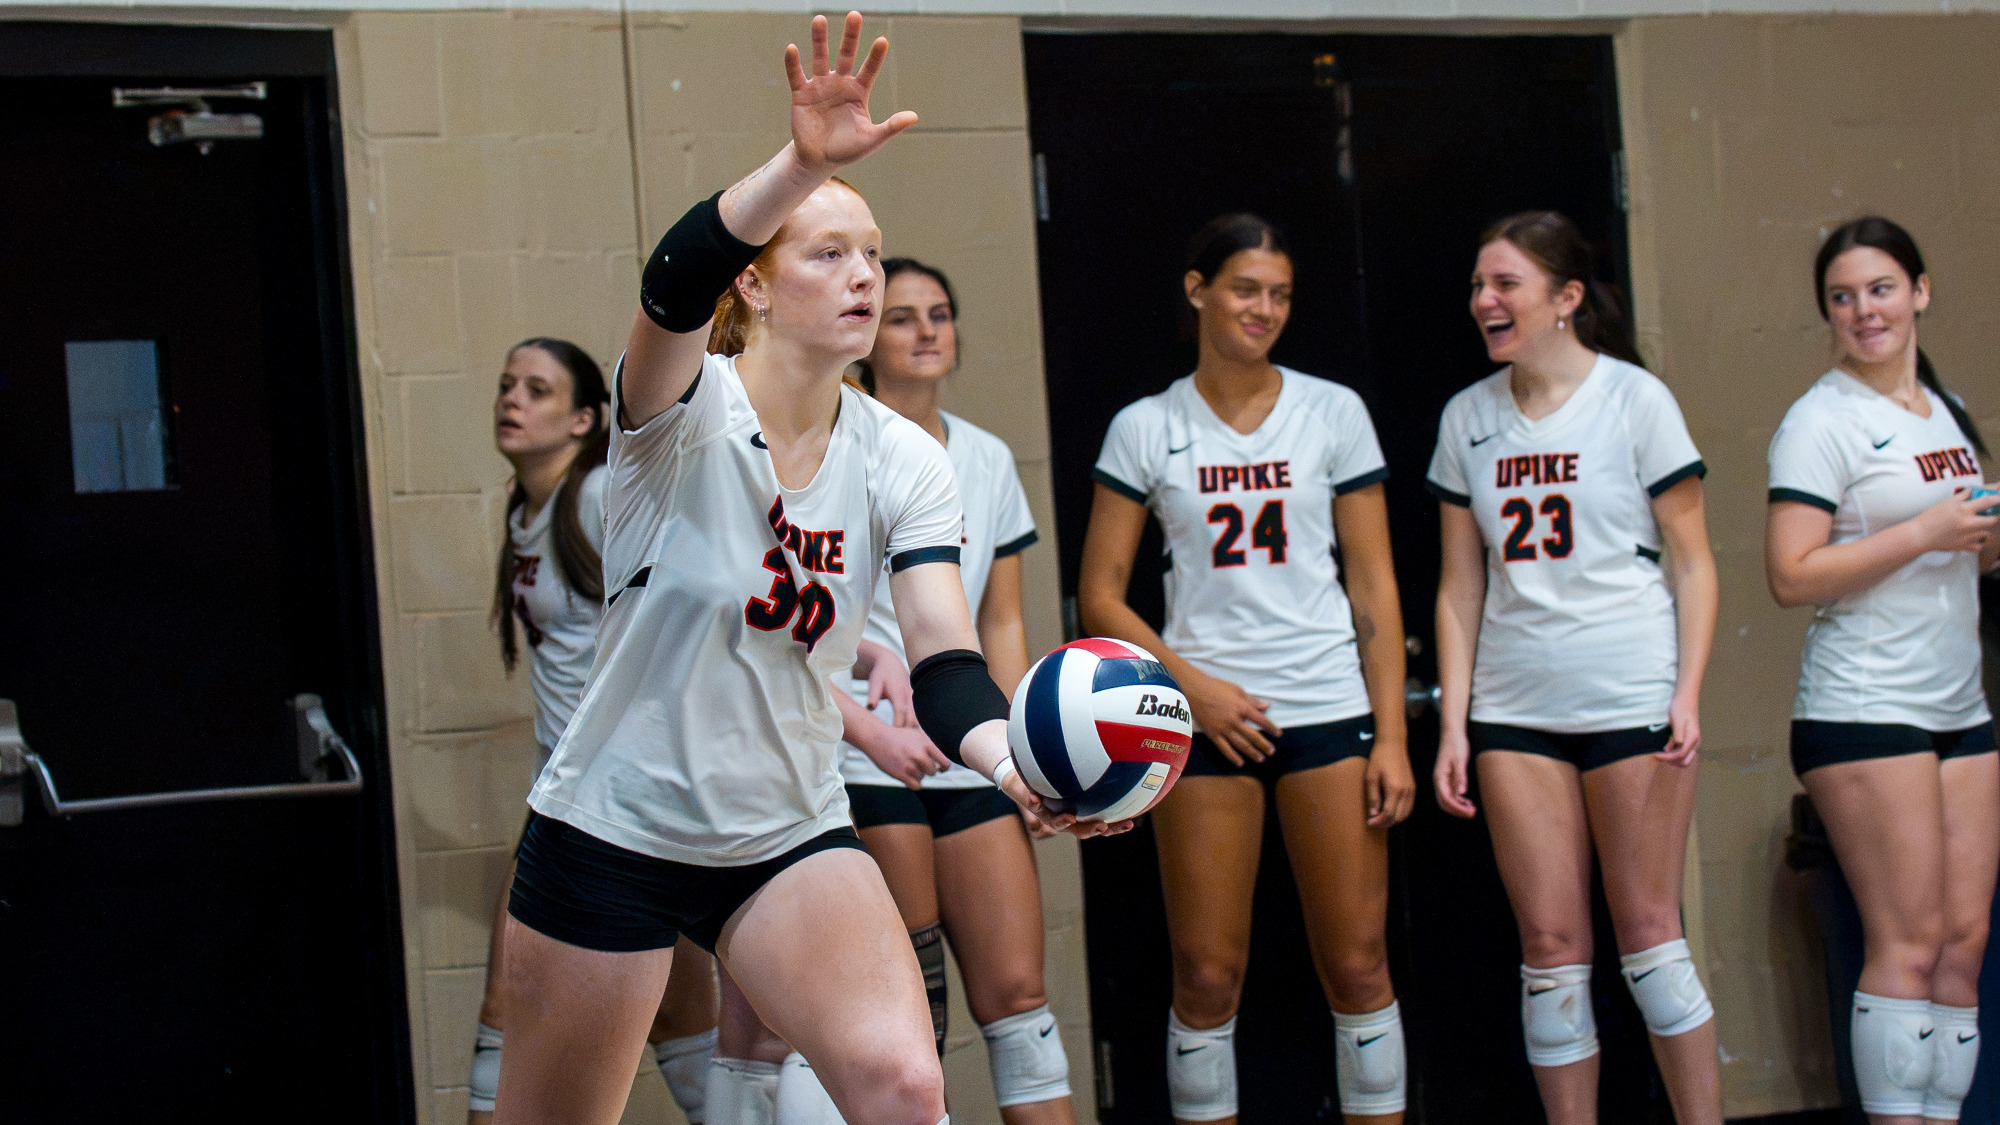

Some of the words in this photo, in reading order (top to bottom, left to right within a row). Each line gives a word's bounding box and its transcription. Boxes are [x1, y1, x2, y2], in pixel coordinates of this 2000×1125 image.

[1198, 459, 1291, 494] UPIKE
[1496, 452, 1579, 489] UPIKE
[1913, 447, 1978, 482] UPIKE
[1206, 498, 1287, 569] 24
[1500, 493, 1574, 563] 23
[744, 545, 836, 654] 30
[1135, 693, 1190, 725] Baden
